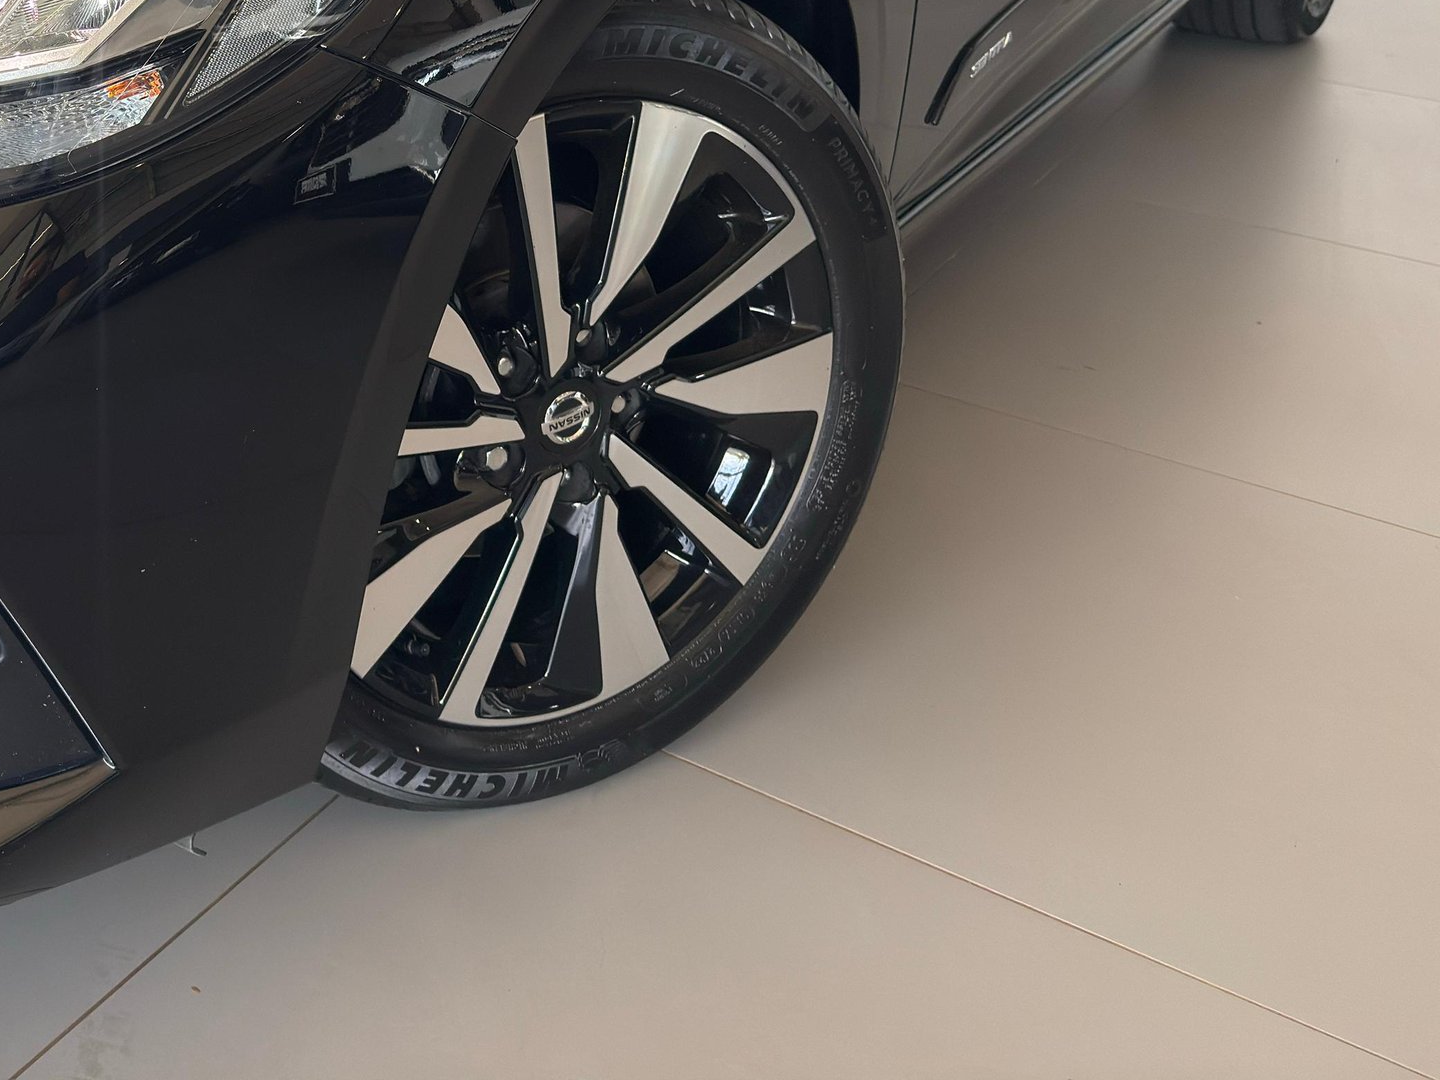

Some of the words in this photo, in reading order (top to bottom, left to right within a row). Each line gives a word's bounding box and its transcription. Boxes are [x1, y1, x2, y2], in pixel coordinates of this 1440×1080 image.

[600, 26, 817, 123] MICHELIN
[827, 136, 876, 213] PRIMACY
[548, 406, 591, 432] NISSAN
[340, 742, 570, 799] MICHELIN
